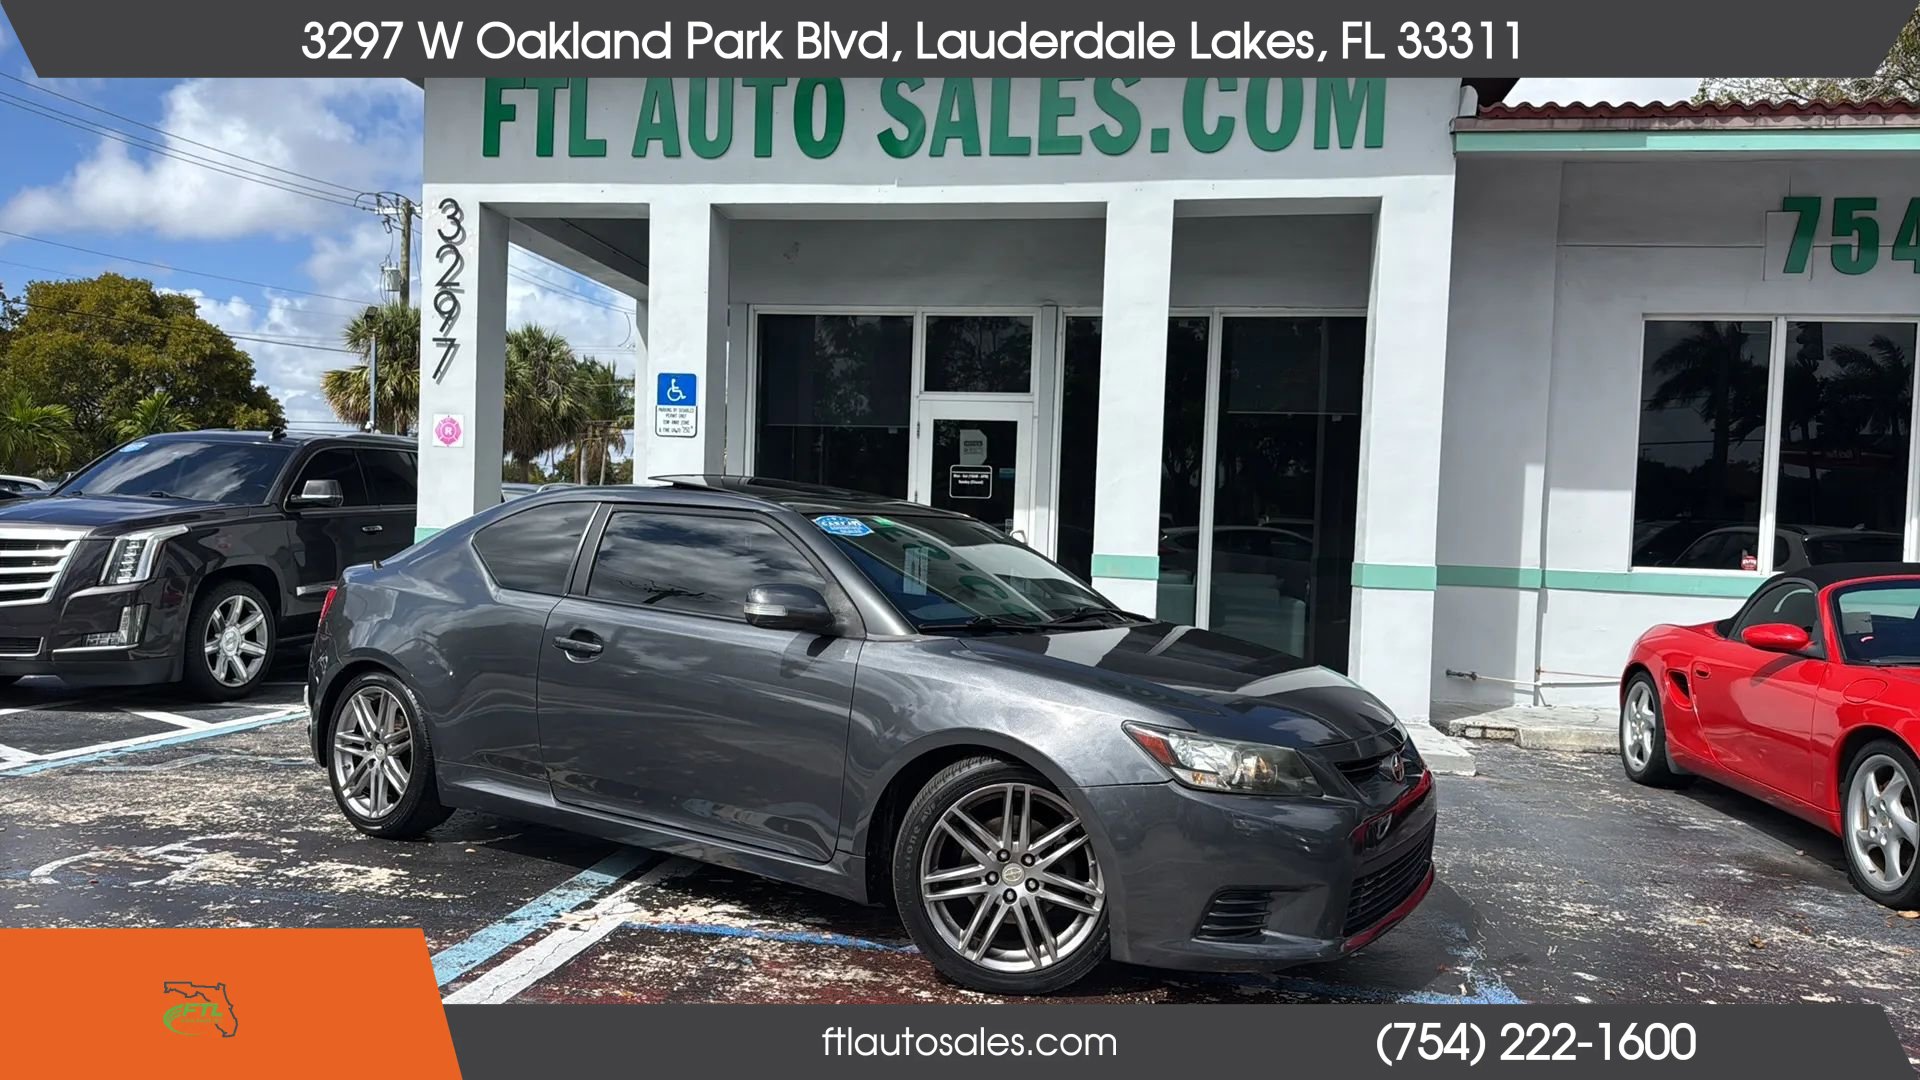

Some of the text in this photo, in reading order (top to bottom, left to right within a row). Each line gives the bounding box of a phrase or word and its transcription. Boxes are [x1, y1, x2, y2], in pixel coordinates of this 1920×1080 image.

[482, 78, 1387, 160] FTL AUTO SALES.COM
[1782, 196, 1920, 276] 754
[432, 197, 463, 381] 3297
